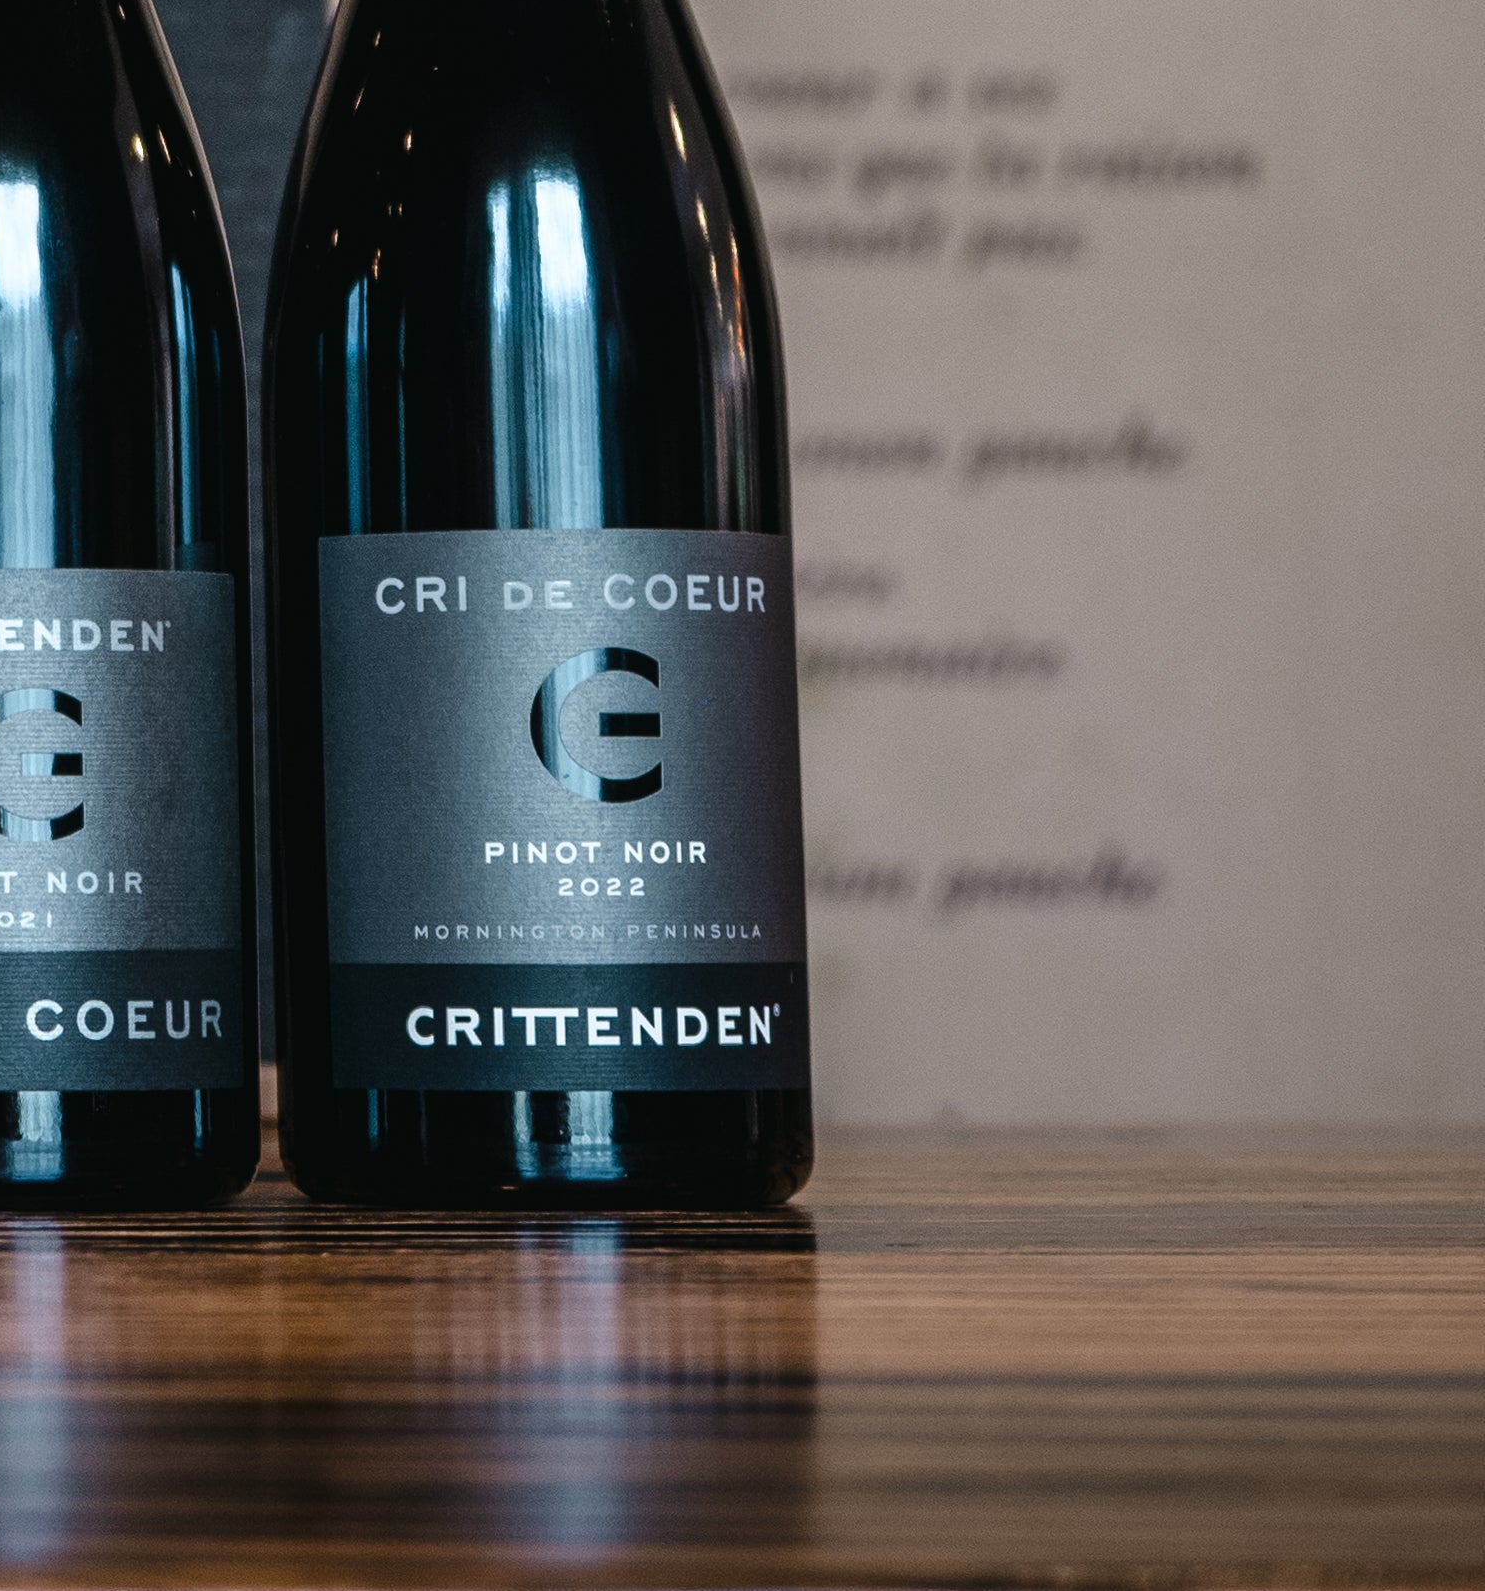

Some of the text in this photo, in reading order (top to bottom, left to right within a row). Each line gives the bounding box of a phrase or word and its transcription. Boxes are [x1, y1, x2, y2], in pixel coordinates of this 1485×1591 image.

[374, 575, 468, 615] CRI
[502, 579, 574, 613] DE
[603, 573, 766, 613] COEUR
[484, 840, 707, 865] PINOT NOIR
[46, 870, 143, 895] NOIR
[557, 876, 646, 898] 2022
[413, 922, 762, 941] MORNINGTON PENINSULA
[25, 999, 222, 1042] COEUR
